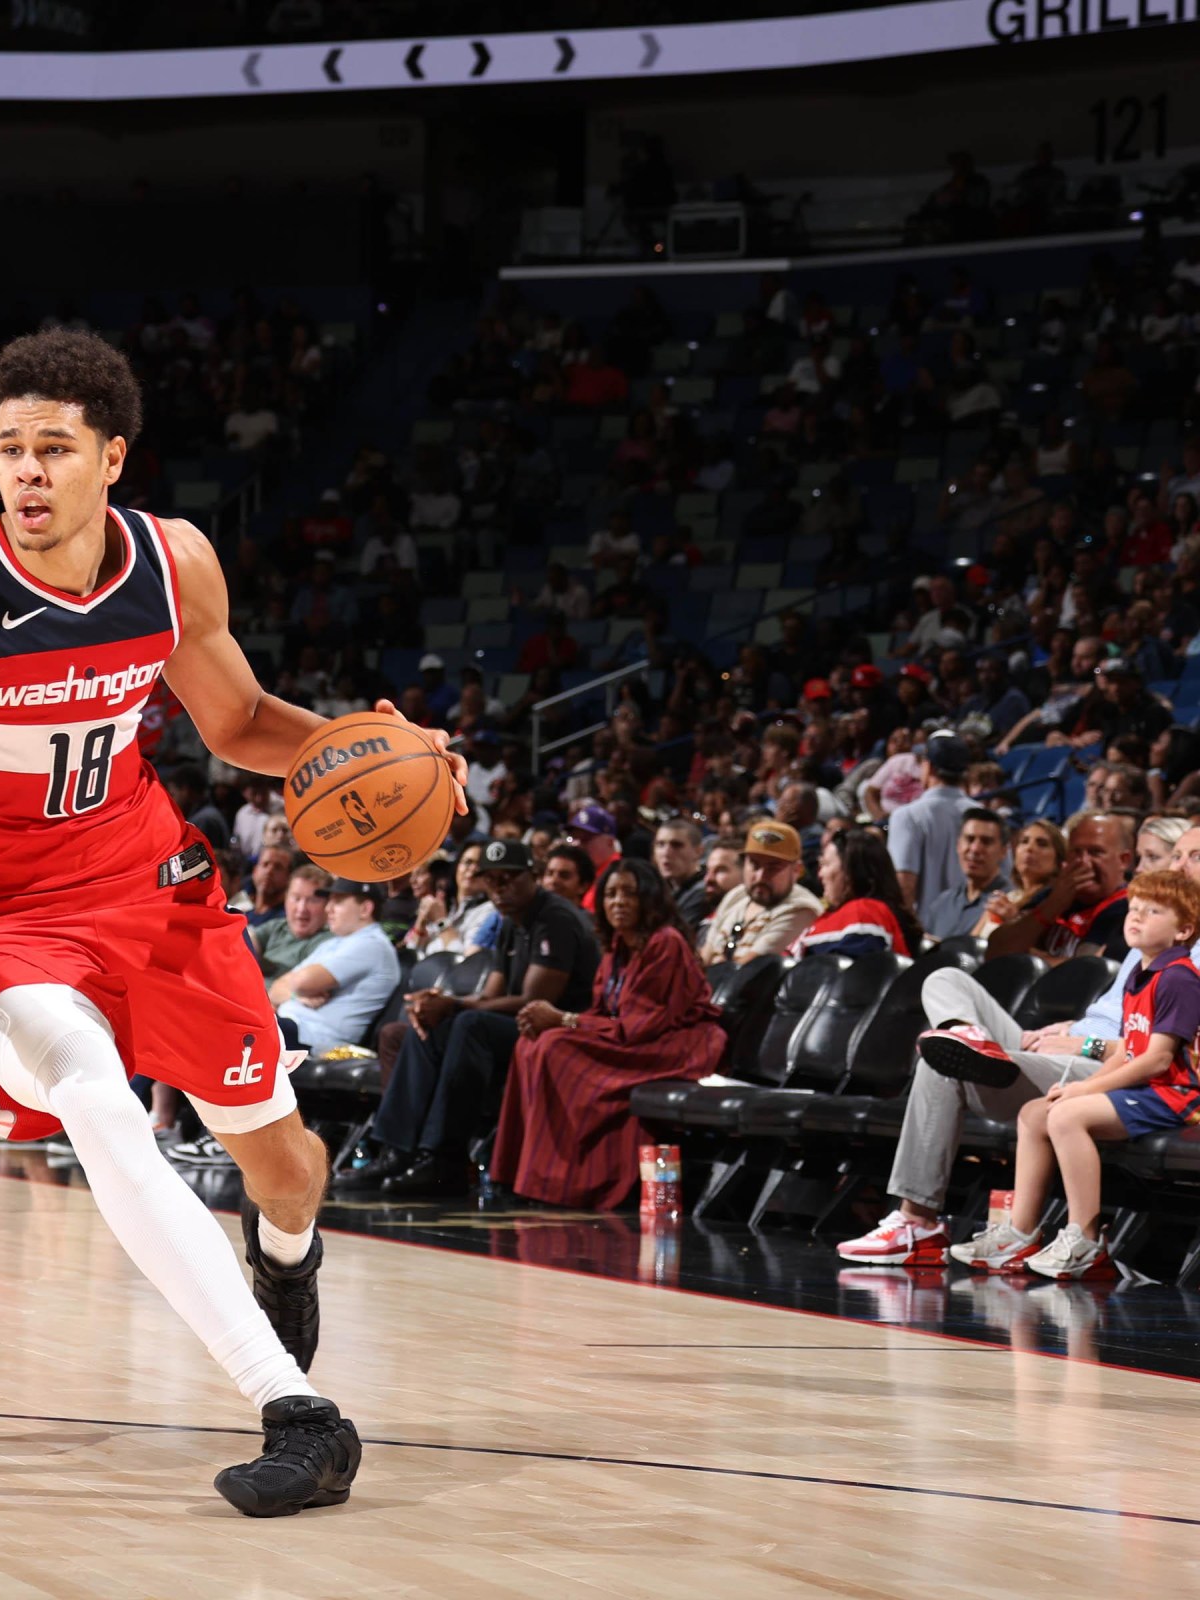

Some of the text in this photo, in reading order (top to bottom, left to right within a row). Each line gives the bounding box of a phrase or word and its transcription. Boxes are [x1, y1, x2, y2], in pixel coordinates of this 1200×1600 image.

[1088, 91, 1168, 165] 121
[43, 722, 116, 819] 18
[290, 736, 392, 799] Wilson
[223, 1046, 264, 1086] dc
